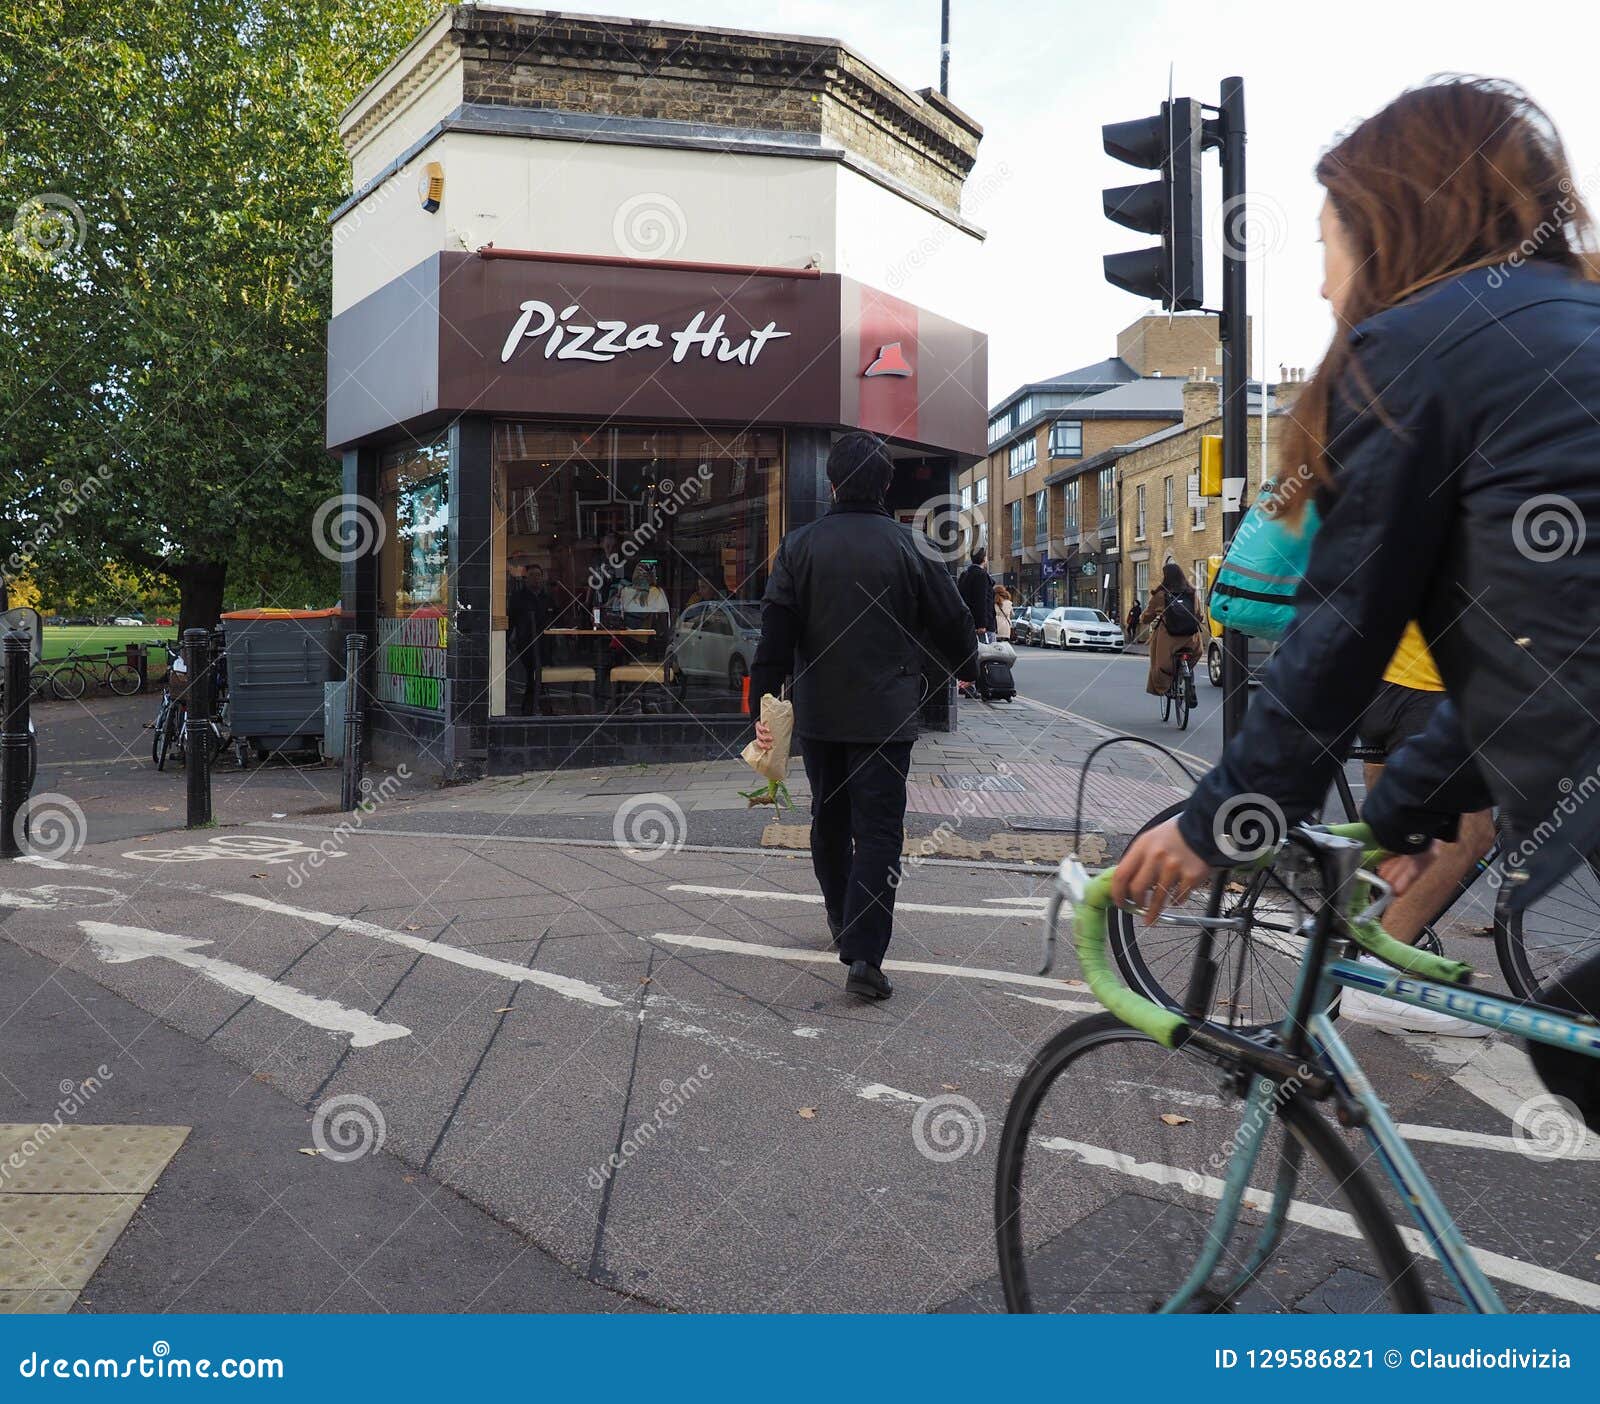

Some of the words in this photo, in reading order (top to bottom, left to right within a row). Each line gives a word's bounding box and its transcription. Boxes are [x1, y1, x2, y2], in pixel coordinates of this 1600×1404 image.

[500, 300, 664, 363] Pizza
[671, 310, 792, 365] Hut
[405, 675, 438, 710] SERVED
